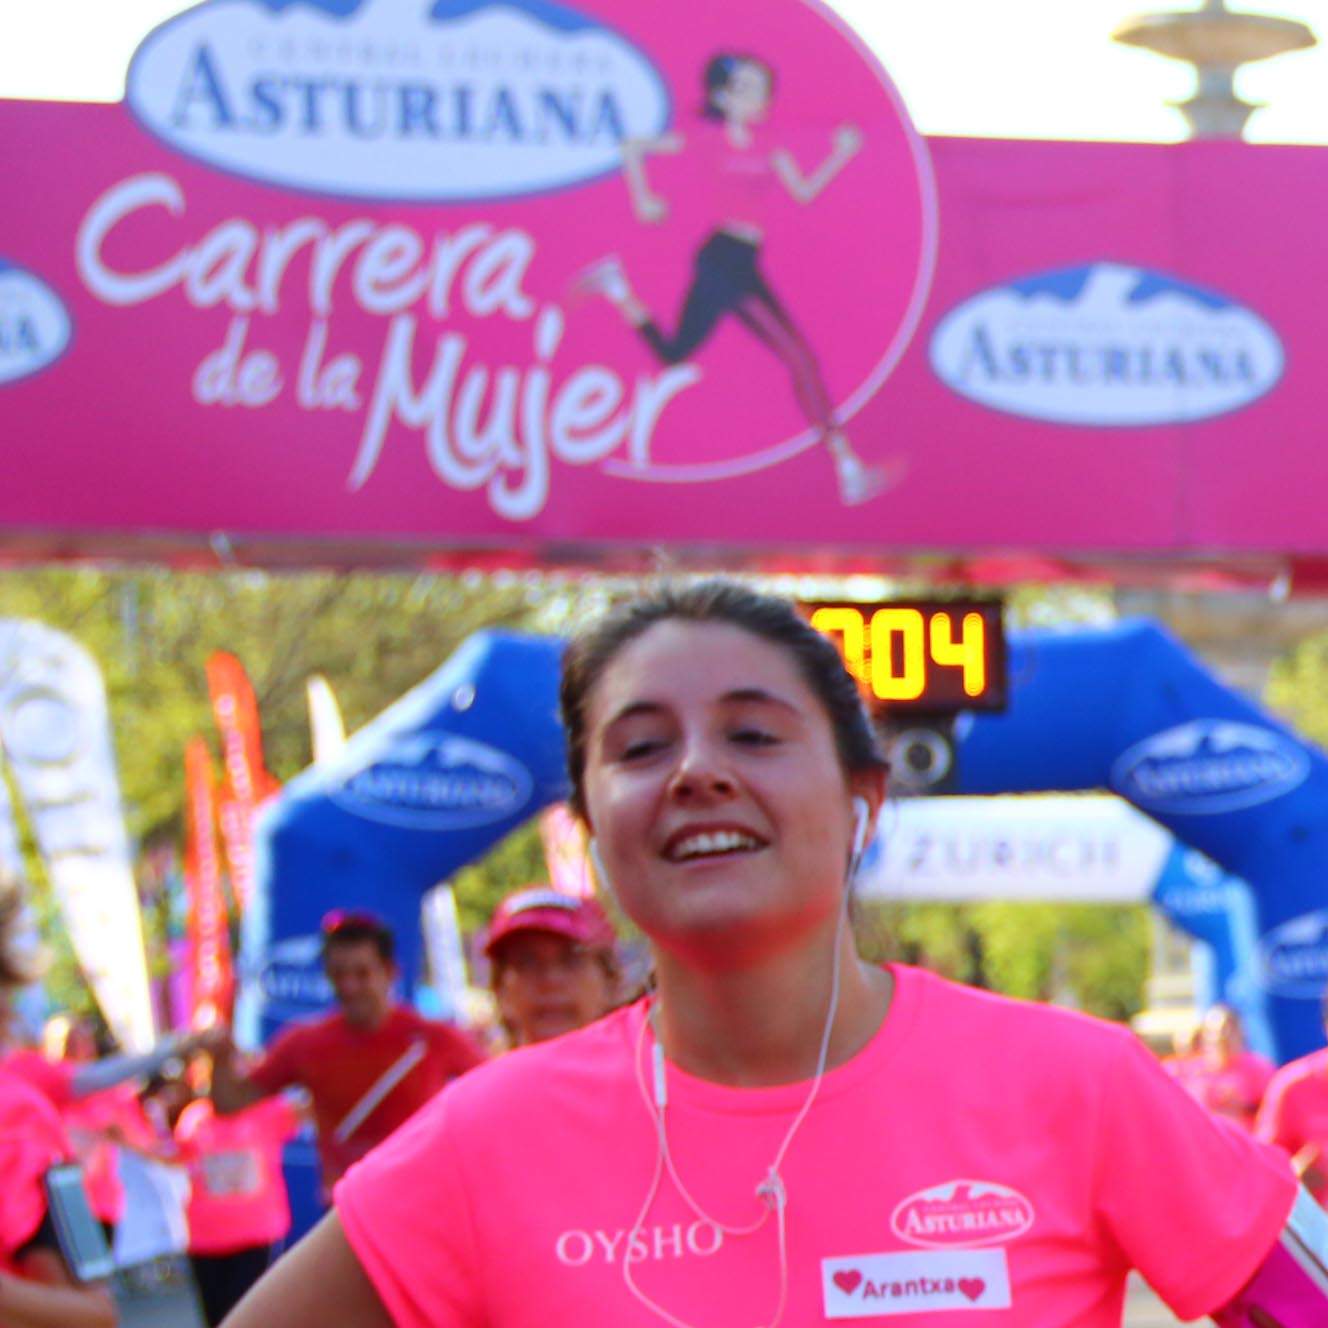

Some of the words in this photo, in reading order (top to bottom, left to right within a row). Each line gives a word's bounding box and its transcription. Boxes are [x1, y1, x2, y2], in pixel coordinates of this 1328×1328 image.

[168, 38, 627, 146] ASTURIANA
[76, 173, 535, 317] Carrera
[958, 321, 1257, 387] ASTURIANA
[191, 315, 283, 408] de
[298, 317, 363, 411] la
[347, 306, 701, 520] Mujer
[555, 1219, 724, 1266] OYSHO
[904, 1207, 1028, 1235] ASTURIANA
[862, 1277, 955, 1300] Arantxa
